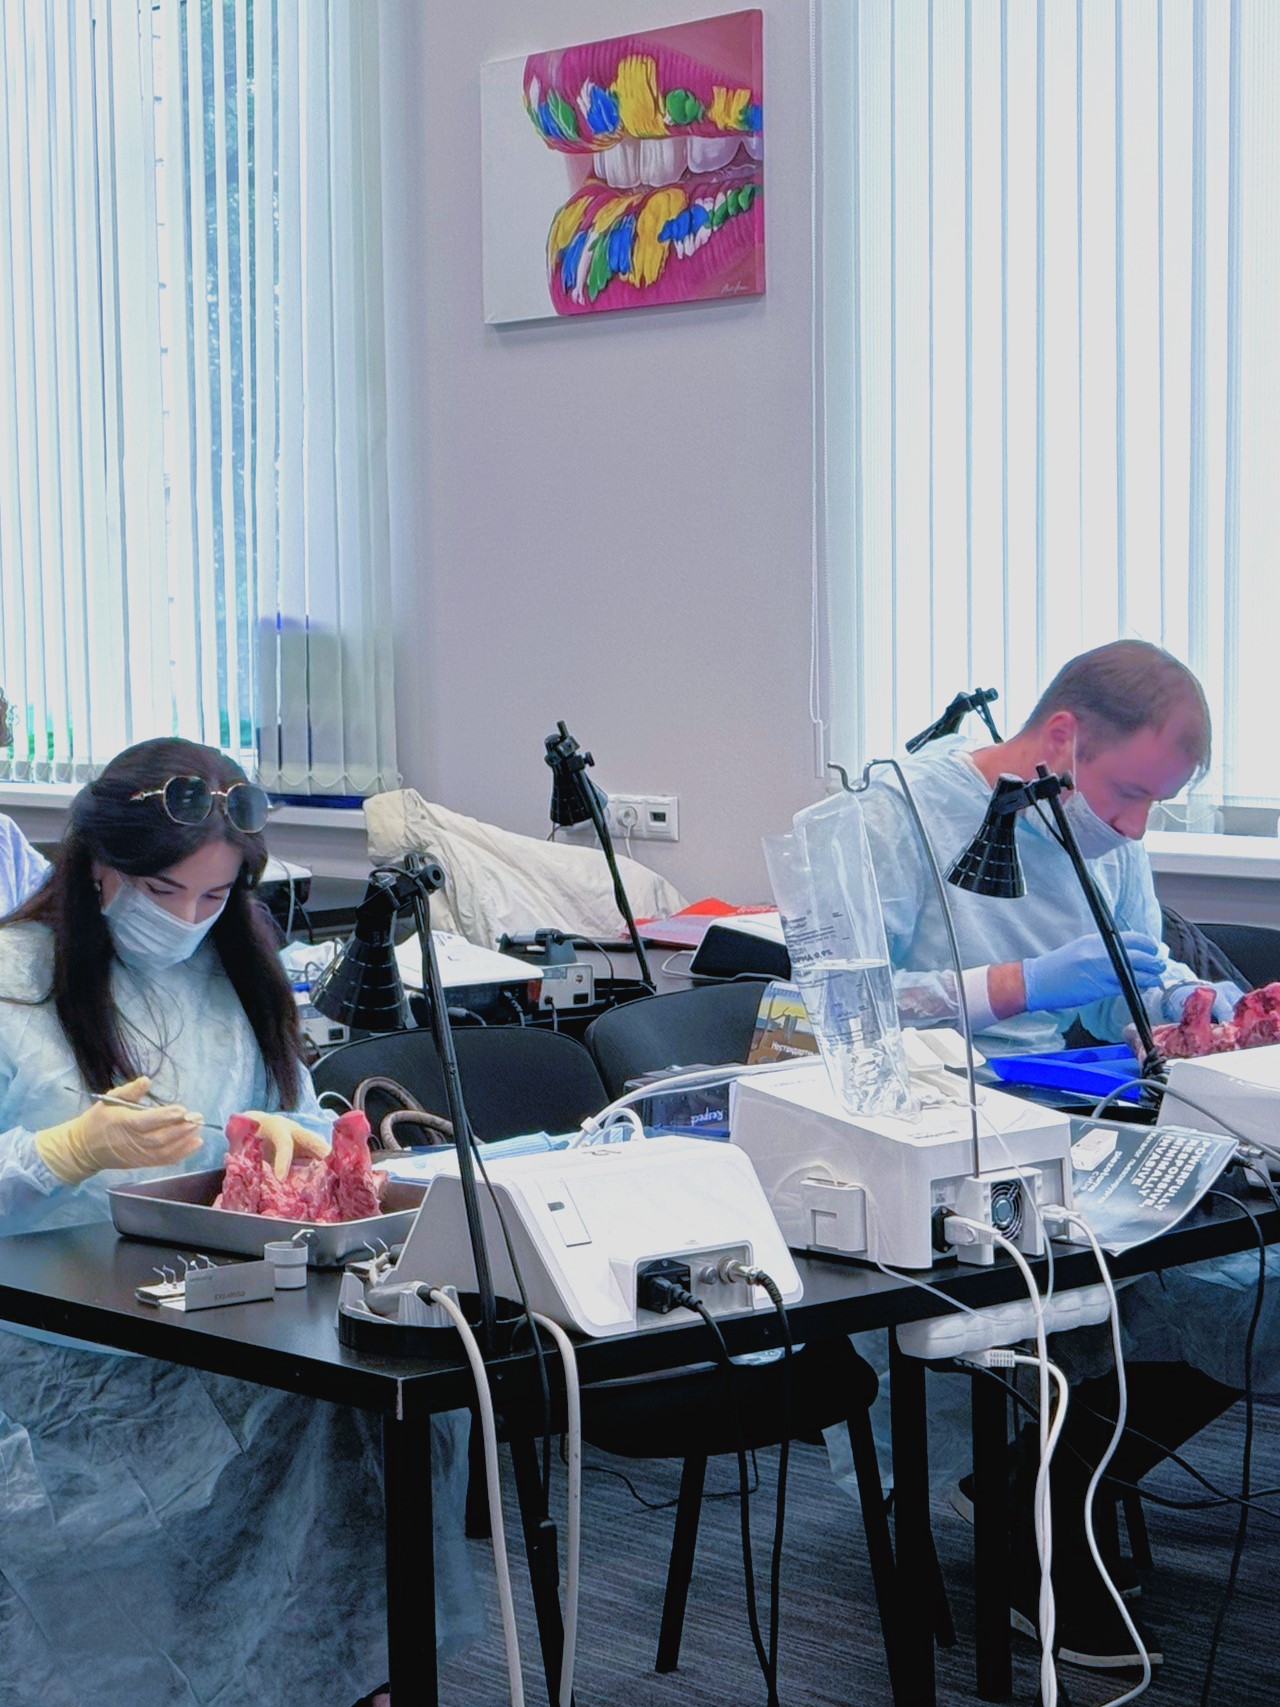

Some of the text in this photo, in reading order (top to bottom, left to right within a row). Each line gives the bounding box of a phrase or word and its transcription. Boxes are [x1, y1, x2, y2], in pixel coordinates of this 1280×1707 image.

[1131, 1135, 1176, 1186] INVASIVE
[1138, 1136, 1190, 1197] MINIMALLY
[1153, 1139, 1212, 1211] POWERFULLY
